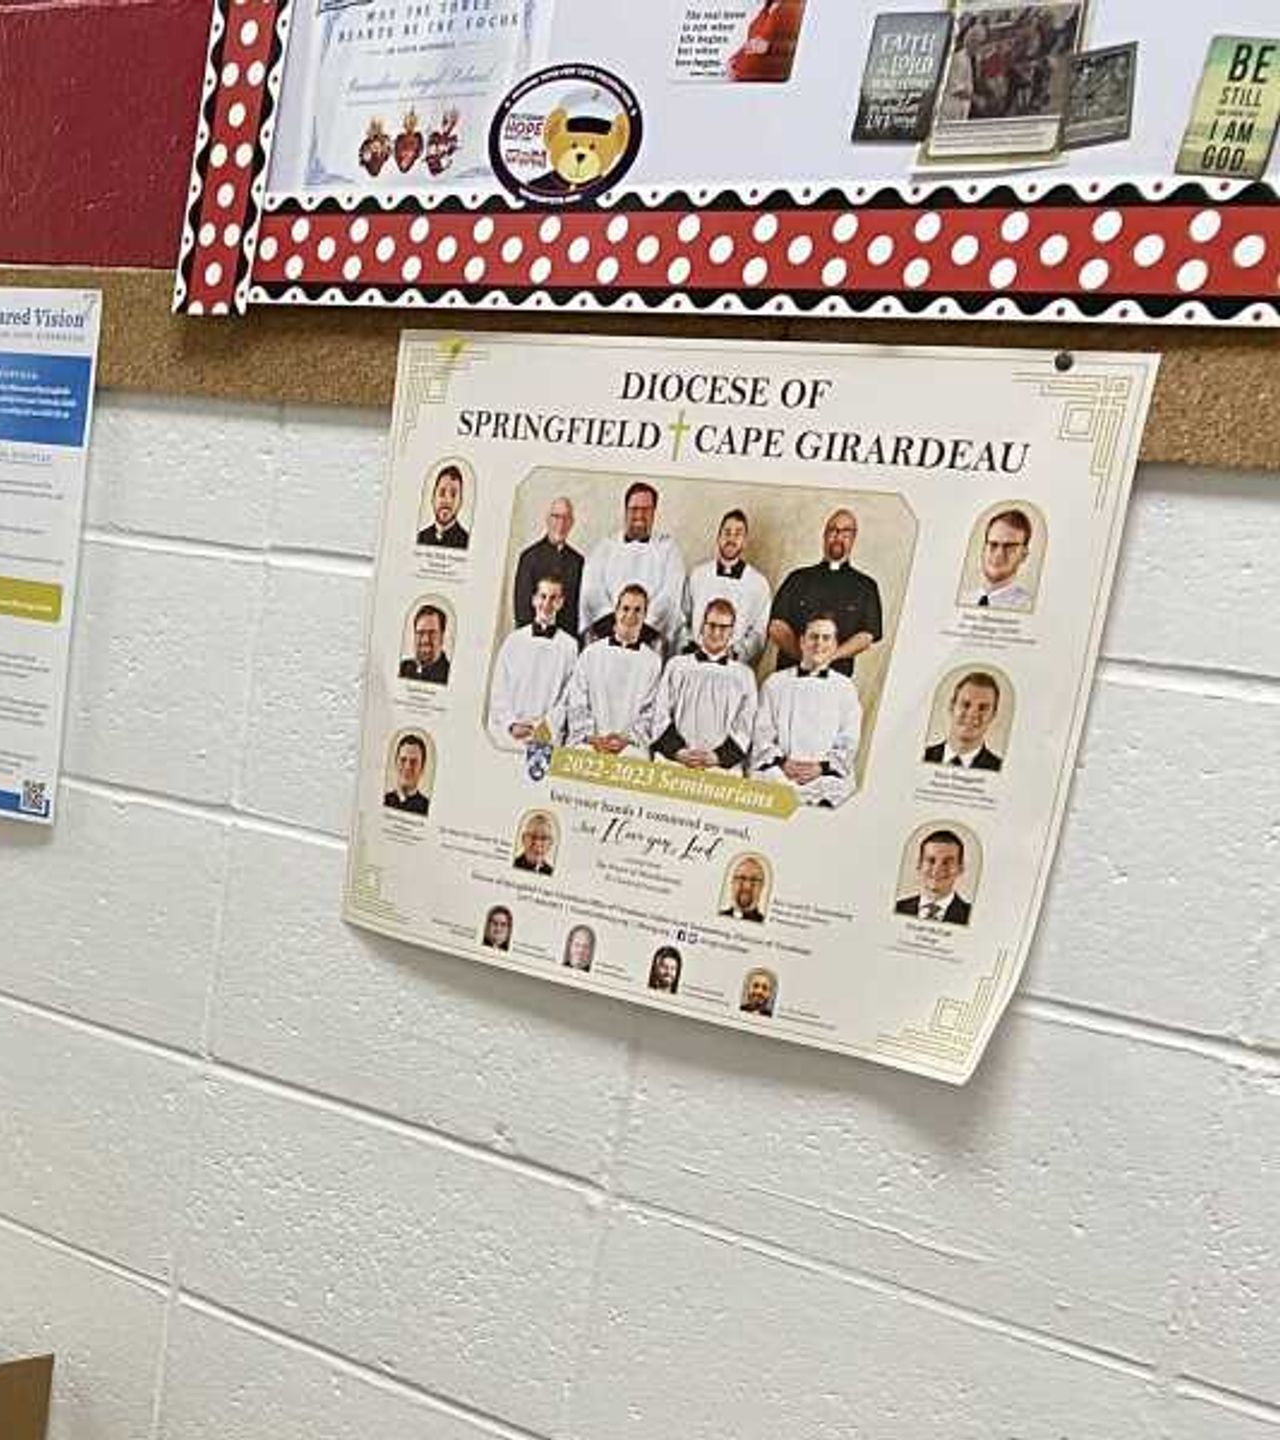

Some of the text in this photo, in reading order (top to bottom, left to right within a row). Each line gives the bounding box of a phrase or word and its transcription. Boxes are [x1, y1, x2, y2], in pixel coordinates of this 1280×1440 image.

[466, 14, 519, 31] FOCUS
[1228, 43, 1277, 83] BE
[1218, 86, 1263, 107] STILL
[1209, 119, 1256, 144] I AM
[34, 309, 86, 329] Vision
[620, 371, 834, 410] DIOCESE OF
[456, 410, 1031, 474] SPRINGFIELD CAPE GIRARDEAU
[560, 755, 775, 809] 2022-2023 Seminarians
